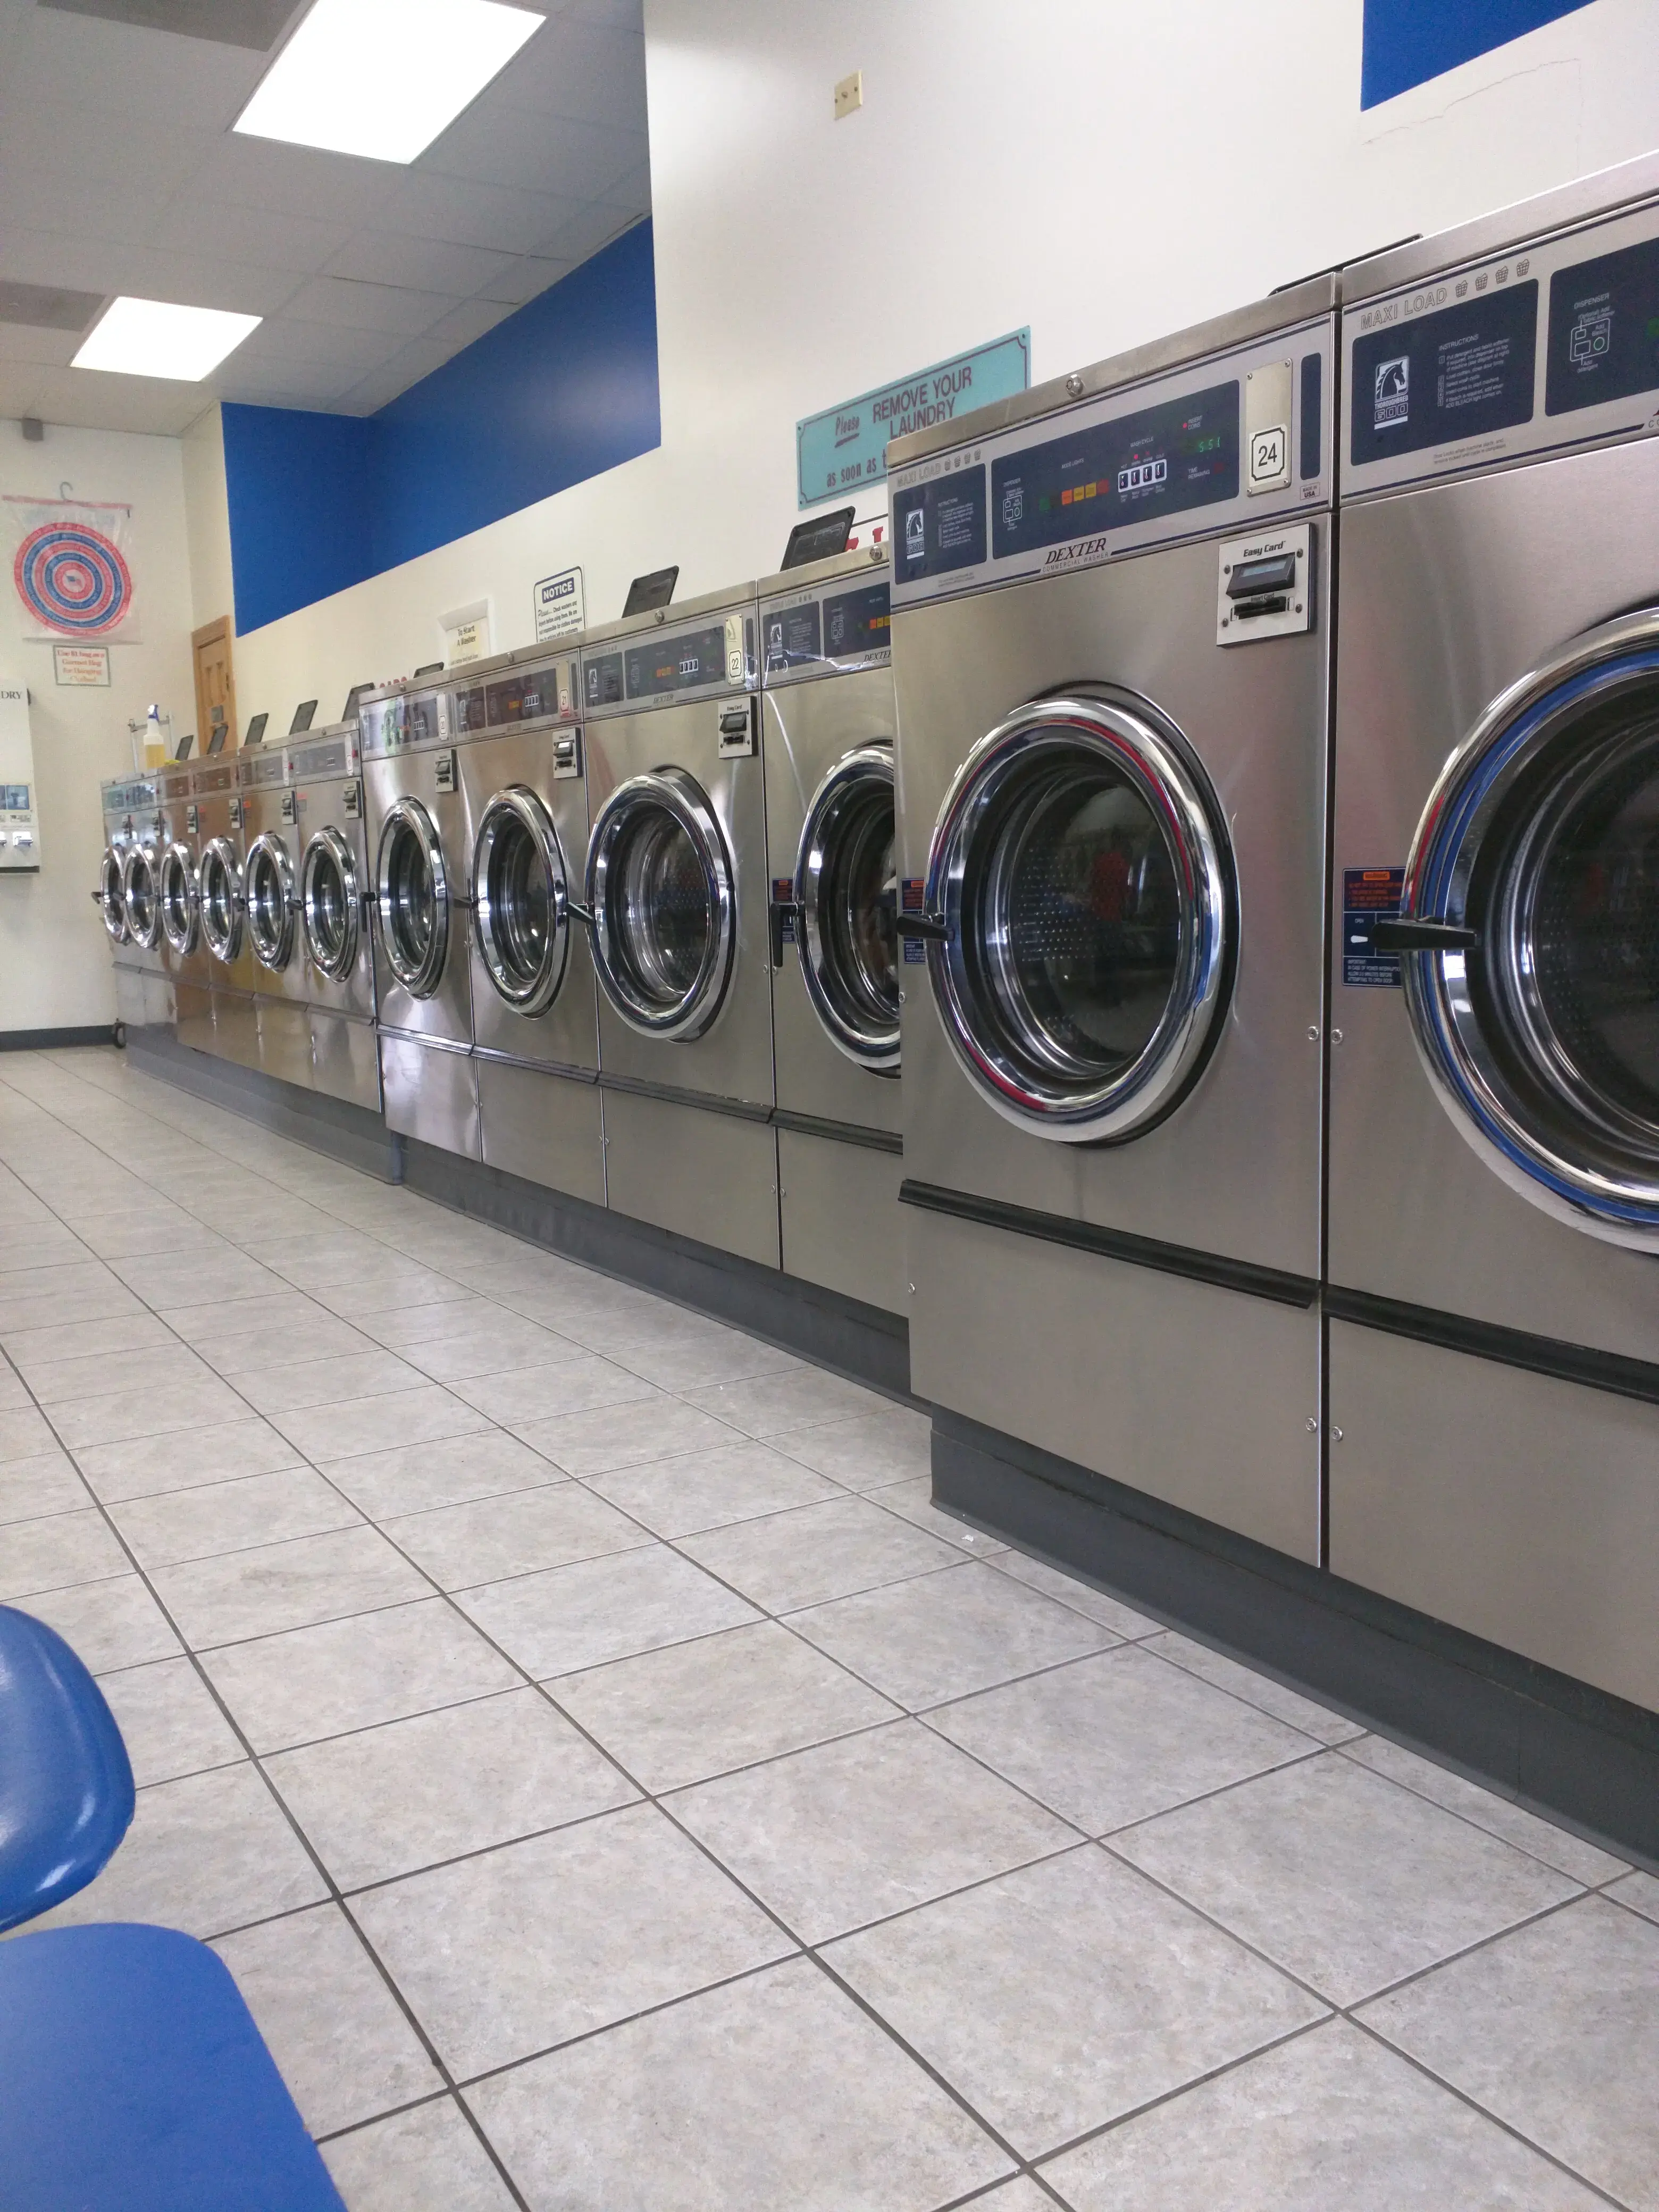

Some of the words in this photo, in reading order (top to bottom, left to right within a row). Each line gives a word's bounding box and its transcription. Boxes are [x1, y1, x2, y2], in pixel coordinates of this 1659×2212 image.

[1361, 304, 1397, 330] MAXI
[1404, 288, 1447, 315] LOAD
[1574, 293, 1610, 309] DISPENSER
[1439, 333, 1479, 351] INSTRUCTIONS
[873, 383, 927, 423] REMOVE
[933, 366, 972, 399] YOUR
[890, 397, 956, 439] LAUNDRY
[1375, 402, 1409, 422] 600
[835, 416, 860, 435] Please
[1258, 442, 1277, 467] 24
[827, 472, 836, 487] as
[841, 462, 861, 483] soon
[867, 457, 876, 474] as
[897, 471, 916, 487] MAXI
[919, 462, 941, 480] LOAD
[1188, 470, 1210, 480] REMAINING
[1045, 538, 1107, 565] DEXTER
[1243, 548, 1262, 557] Easy
[1043, 559, 1080, 573] COMMERCIAL
[1084, 552, 1108, 563] WASHER
[543, 581, 573, 600] NOTICE
[463, 625, 475, 634] Start
[732, 658, 739, 670] 22
[1, 691, 22, 700] DRY
[653, 694, 674, 704] DEXTER
